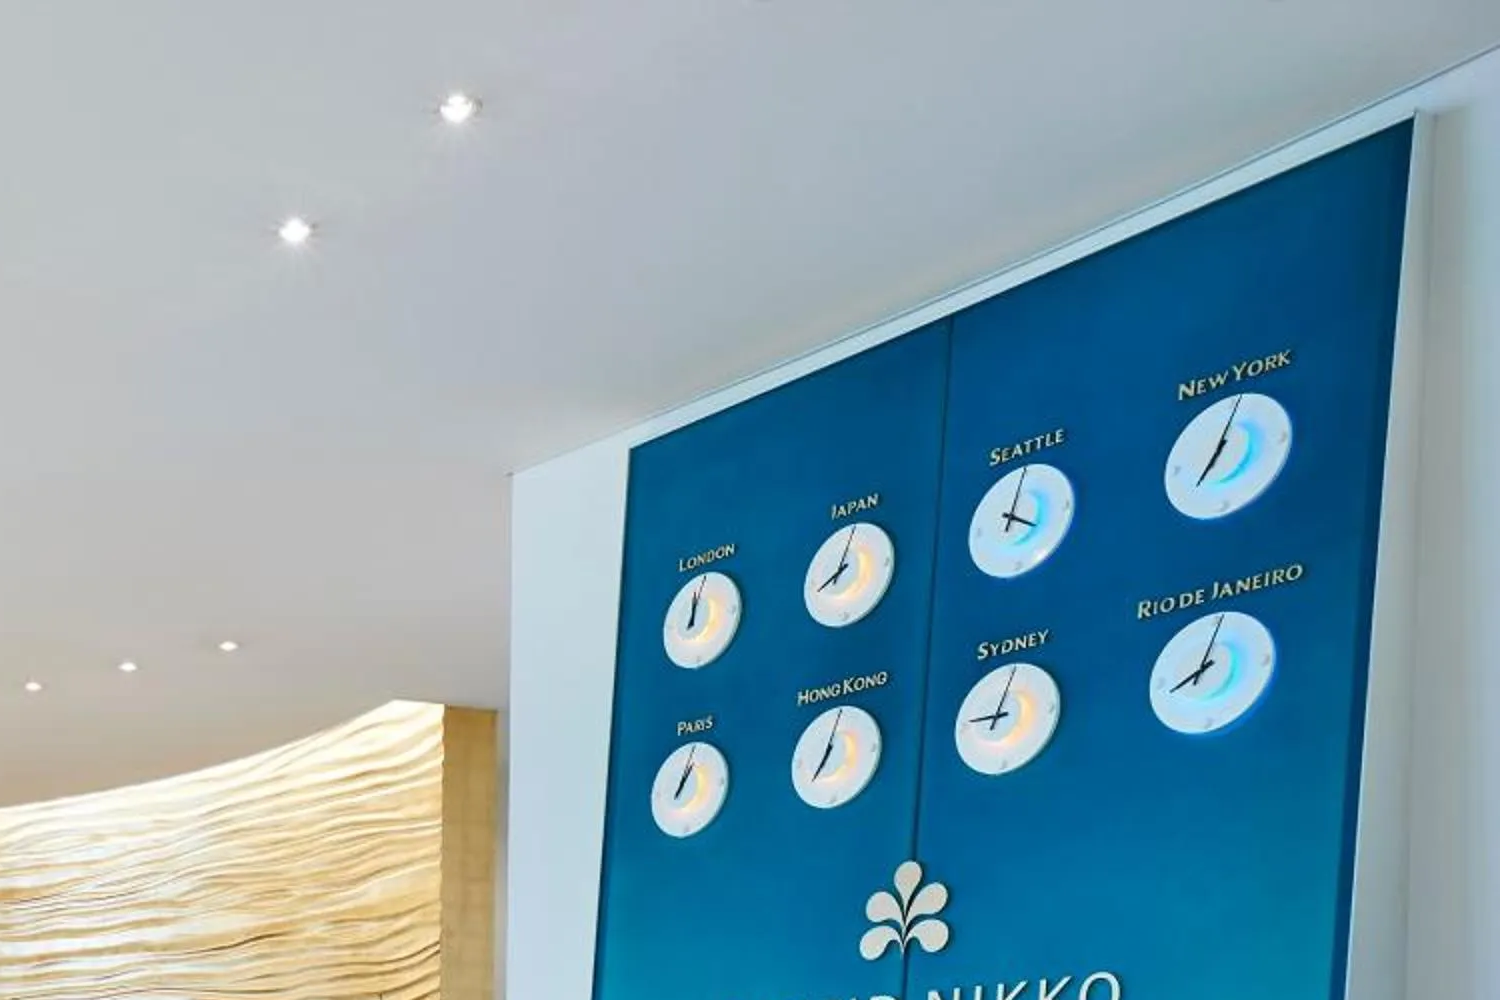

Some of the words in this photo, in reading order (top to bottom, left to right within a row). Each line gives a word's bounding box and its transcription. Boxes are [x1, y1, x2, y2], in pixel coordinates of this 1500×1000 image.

[1178, 370, 1229, 401] NEW
[1232, 349, 1291, 381] YORK
[989, 428, 1065, 466] SEATTLE
[831, 493, 879, 520] JAPAN
[678, 543, 736, 572] LONDON
[1137, 597, 1175, 619] RIO
[1179, 589, 1205, 608] DE
[1211, 564, 1303, 600] JANEIRO
[977, 628, 1049, 661] SYDNEY
[797, 683, 841, 706] HONG
[843, 671, 888, 695] KONG
[677, 715, 713, 736] PARIS
